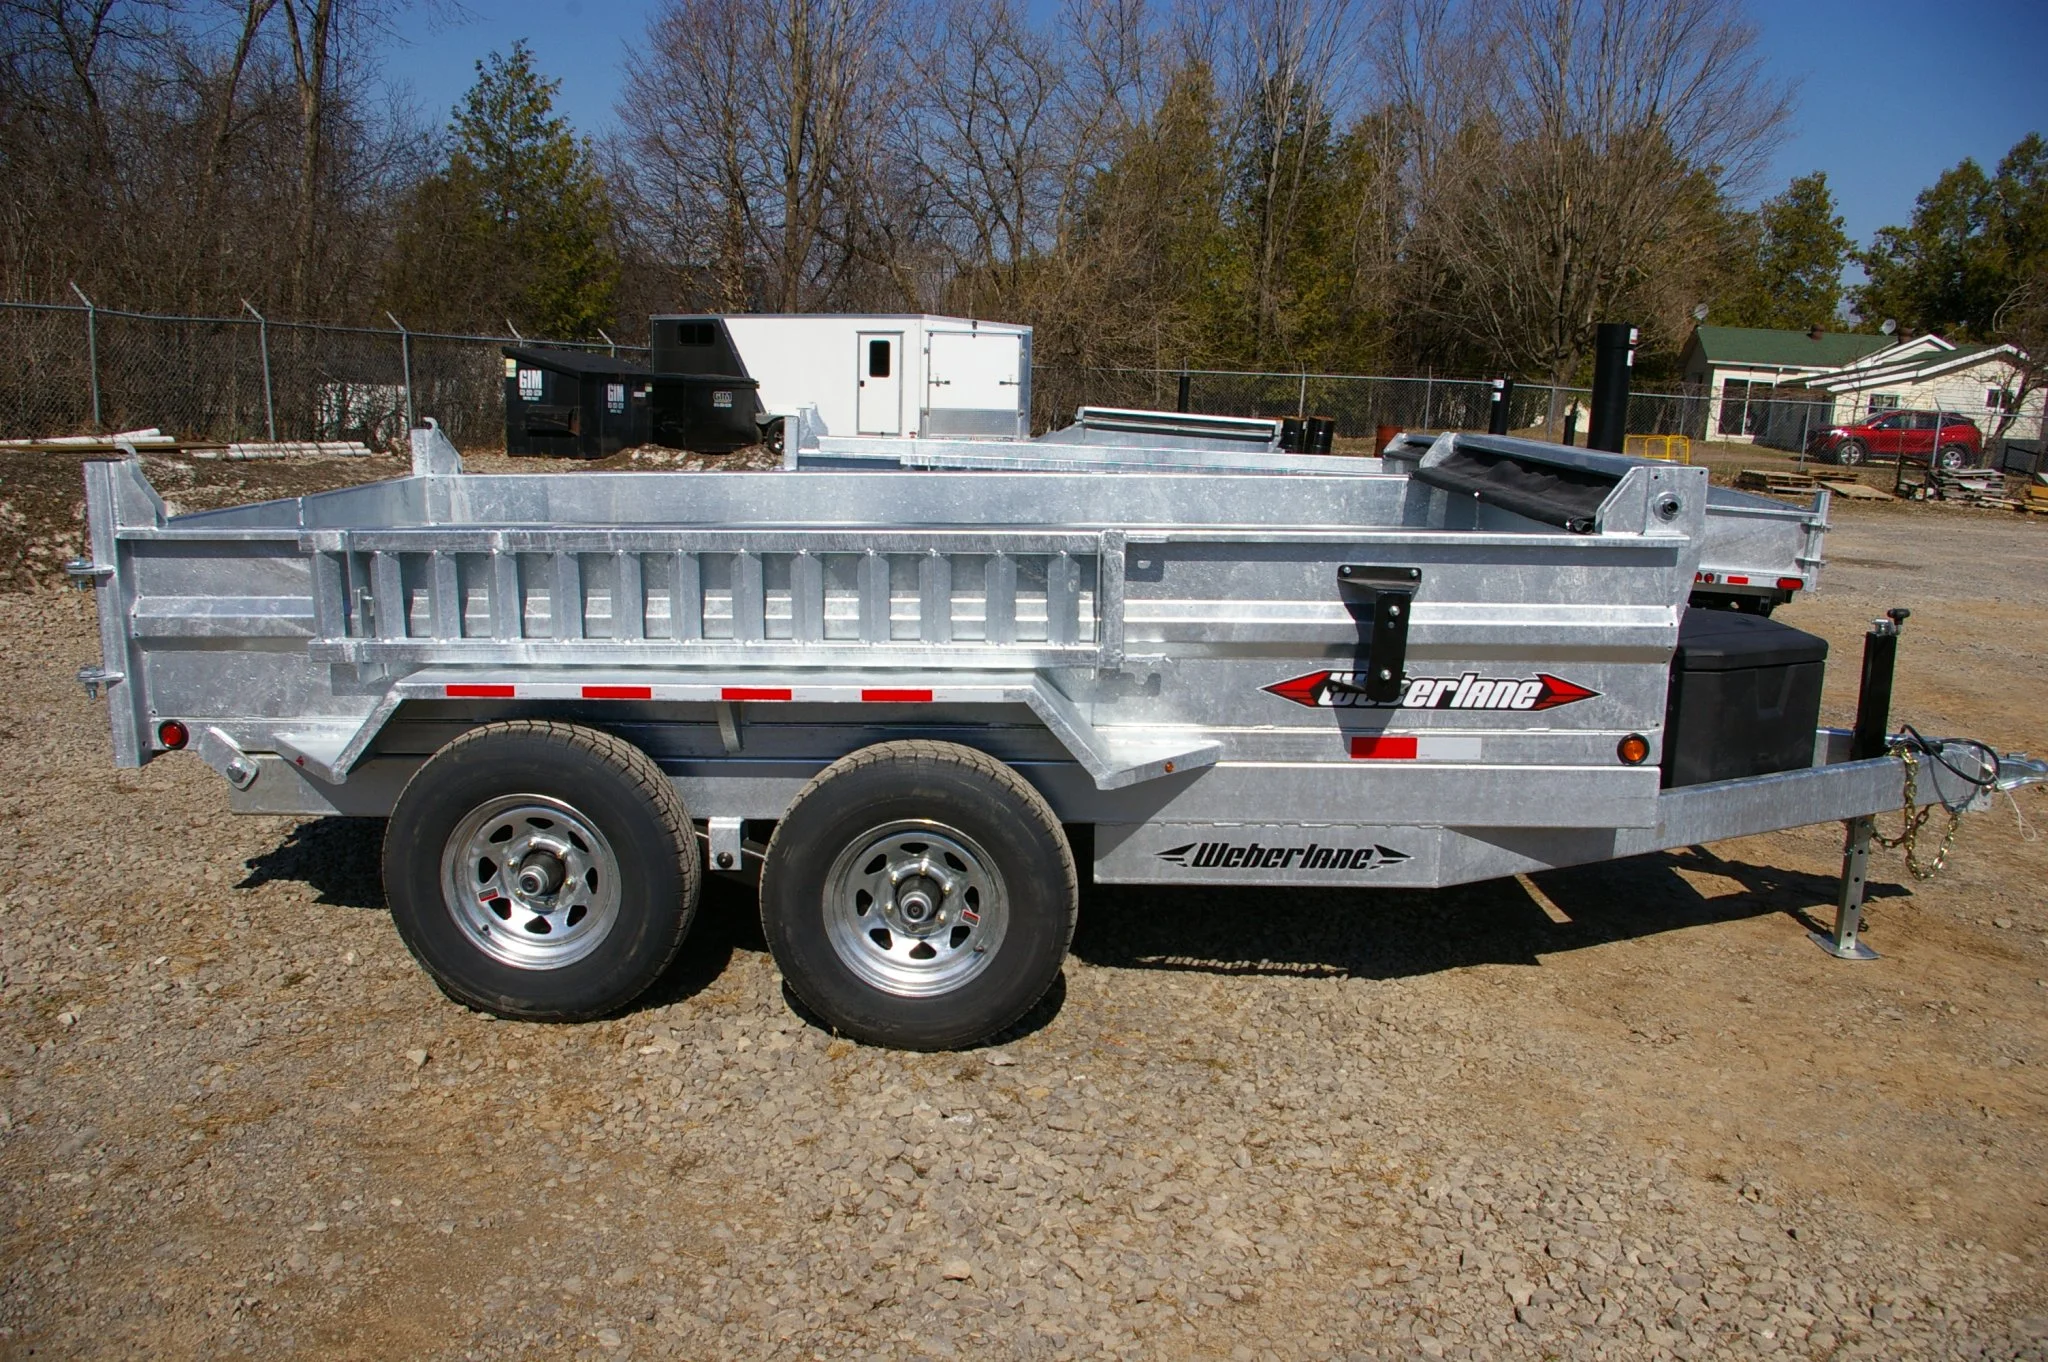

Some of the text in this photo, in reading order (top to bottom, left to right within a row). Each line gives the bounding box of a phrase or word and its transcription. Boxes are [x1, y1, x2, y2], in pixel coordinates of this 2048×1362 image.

[519, 369, 542, 389] GIM
[607, 383, 624, 402] GIM
[1317, 672, 1544, 709] Werlane
[1191, 842, 1374, 869] Weberlane
